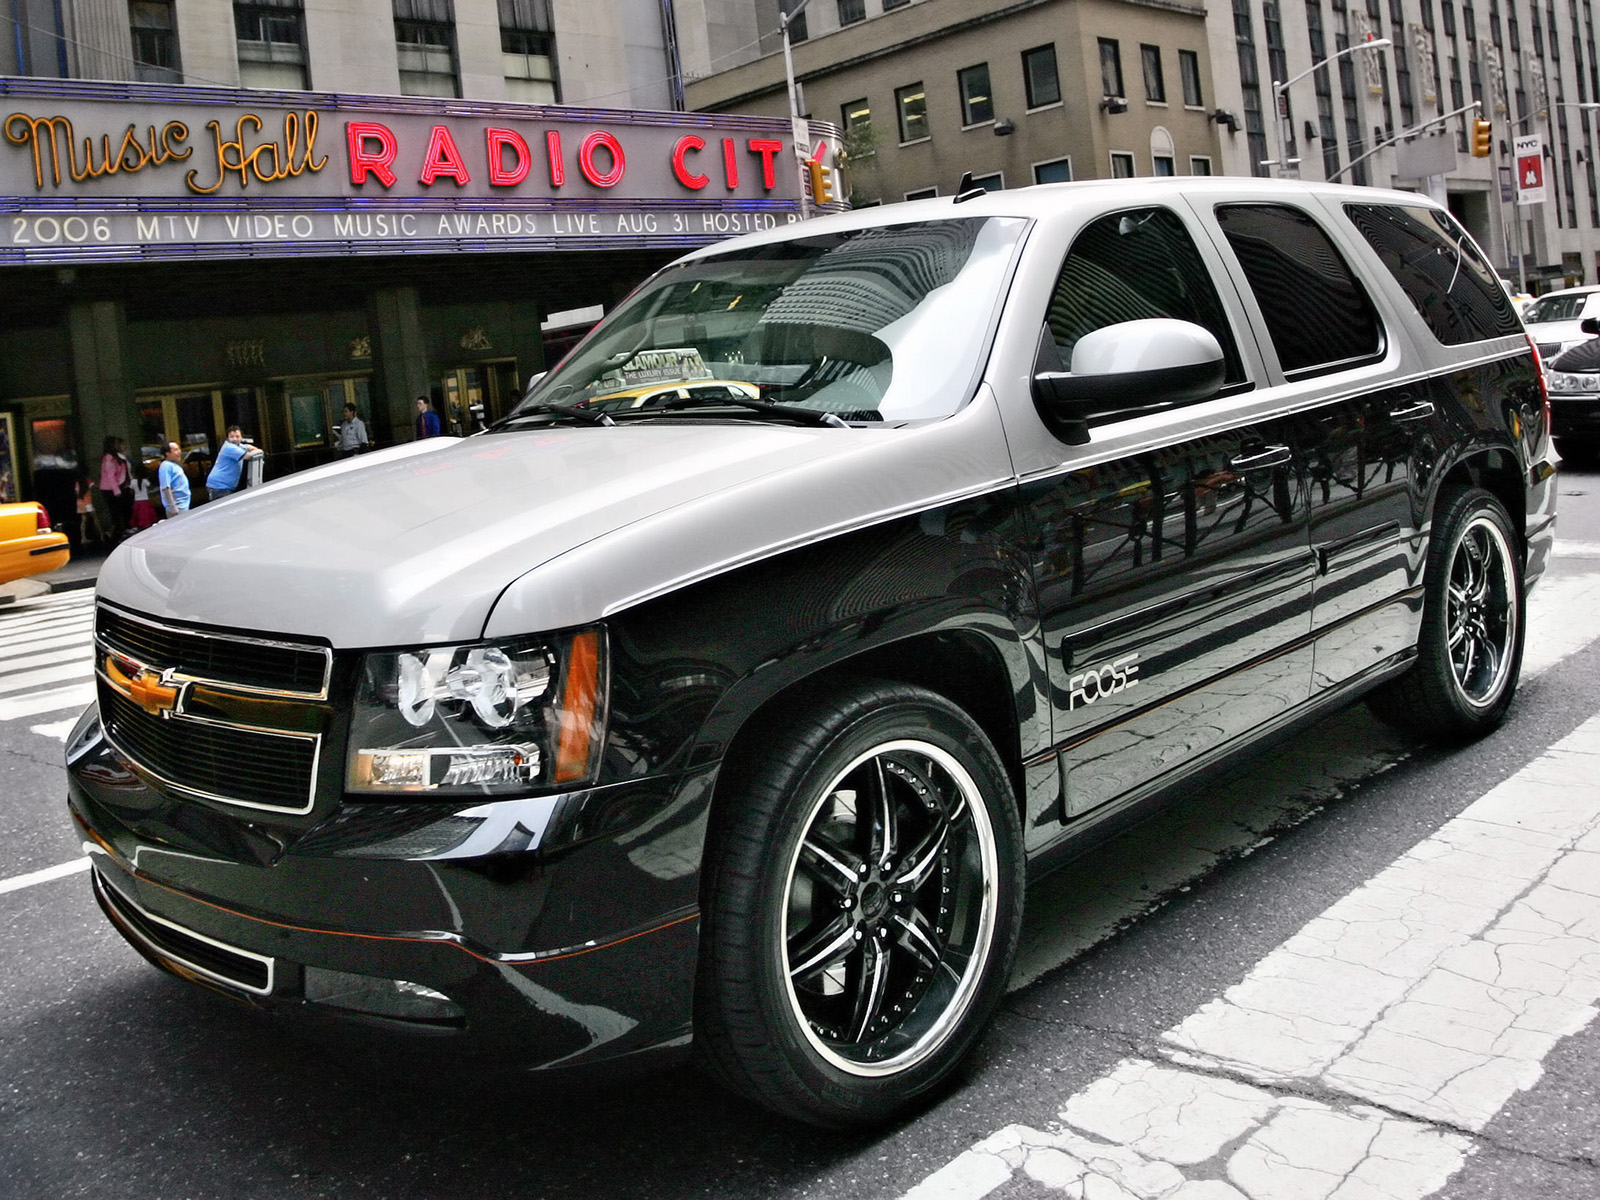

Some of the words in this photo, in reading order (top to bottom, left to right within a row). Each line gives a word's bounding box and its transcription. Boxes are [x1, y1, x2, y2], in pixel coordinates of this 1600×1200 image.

[5, 112, 193, 188] Music
[185, 110, 328, 193] Hall
[345, 121, 626, 189] RADIO
[1516, 140, 1538, 148] NYC
[13, 217, 111, 243] 2006
[137, 215, 200, 240] MTV
[225, 214, 314, 239] VIDEO
[334, 213, 417, 237] MUSIC
[437, 213, 536, 235] AWARDS
[553, 213, 601, 234] LIVE
[617, 213, 658, 233] AUG
[673, 213, 690, 232] 31
[703, 213, 776, 232] HOSTED
[624, 371, 637, 379] THE
[638, 368, 662, 378] LUXURY
[663, 366, 682, 376] ISSUE
[1069, 653, 1139, 711] FOOSE
